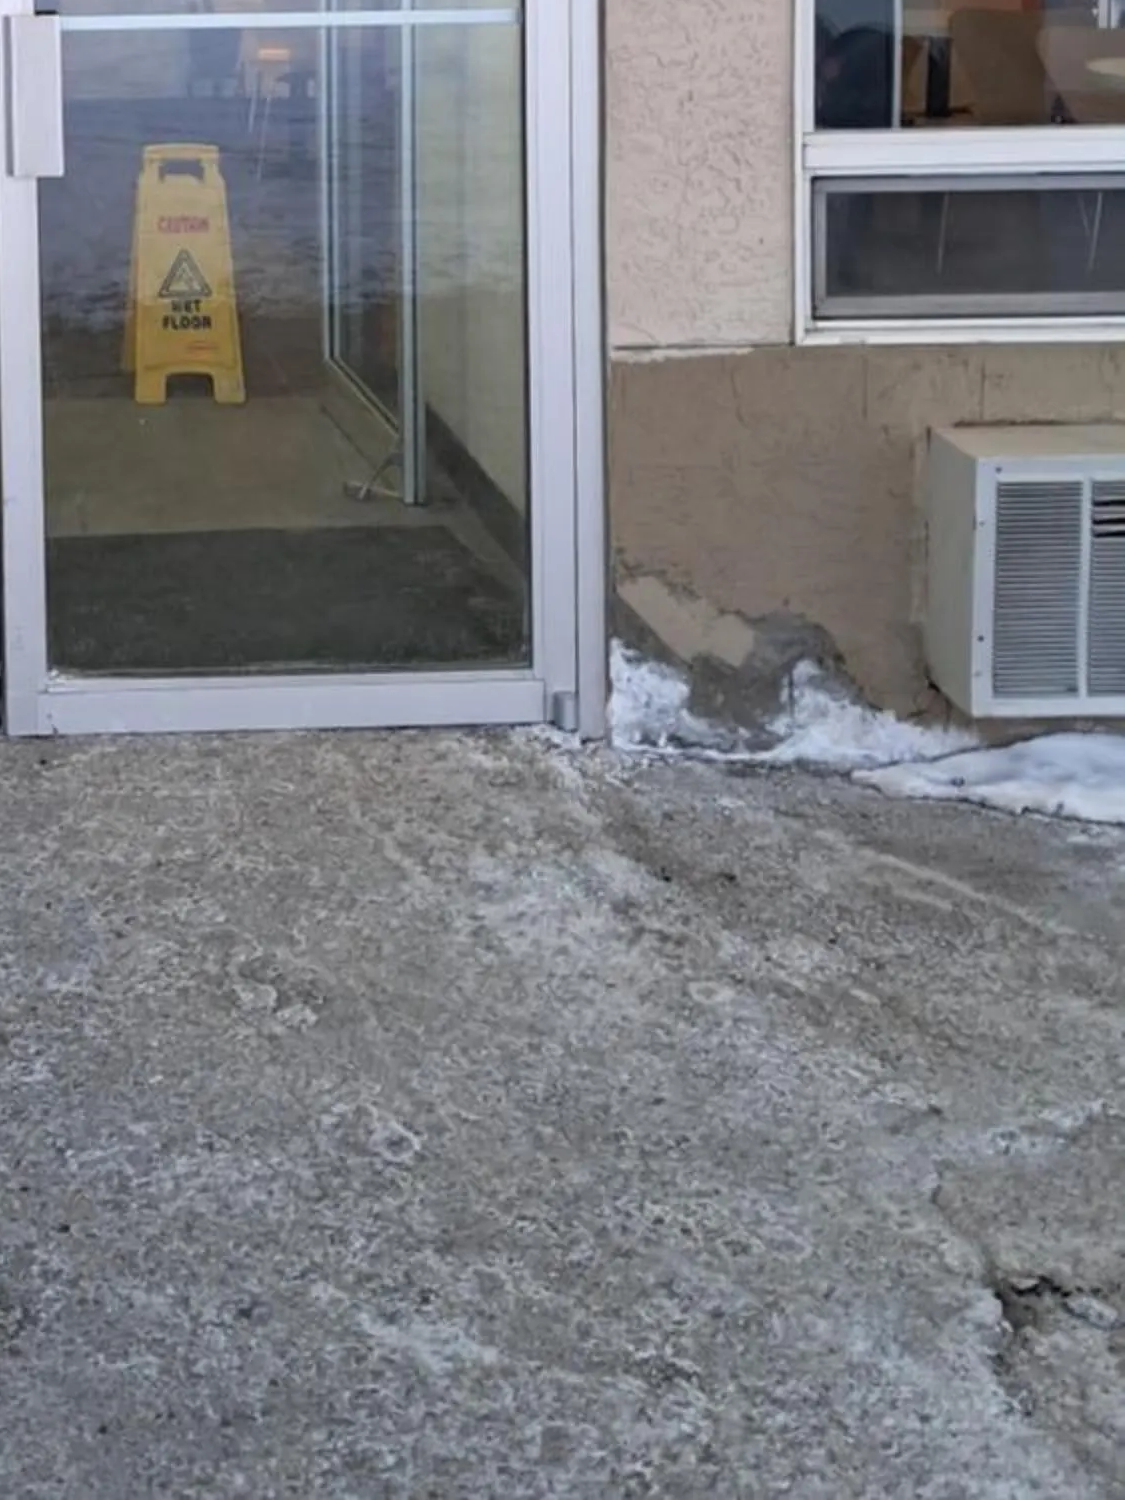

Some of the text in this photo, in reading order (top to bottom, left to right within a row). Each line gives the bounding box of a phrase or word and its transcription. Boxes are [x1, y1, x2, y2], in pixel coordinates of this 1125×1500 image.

[157, 215, 210, 233] CAUTION
[171, 299, 202, 313] WET
[161, 314, 212, 330] FLOOR
